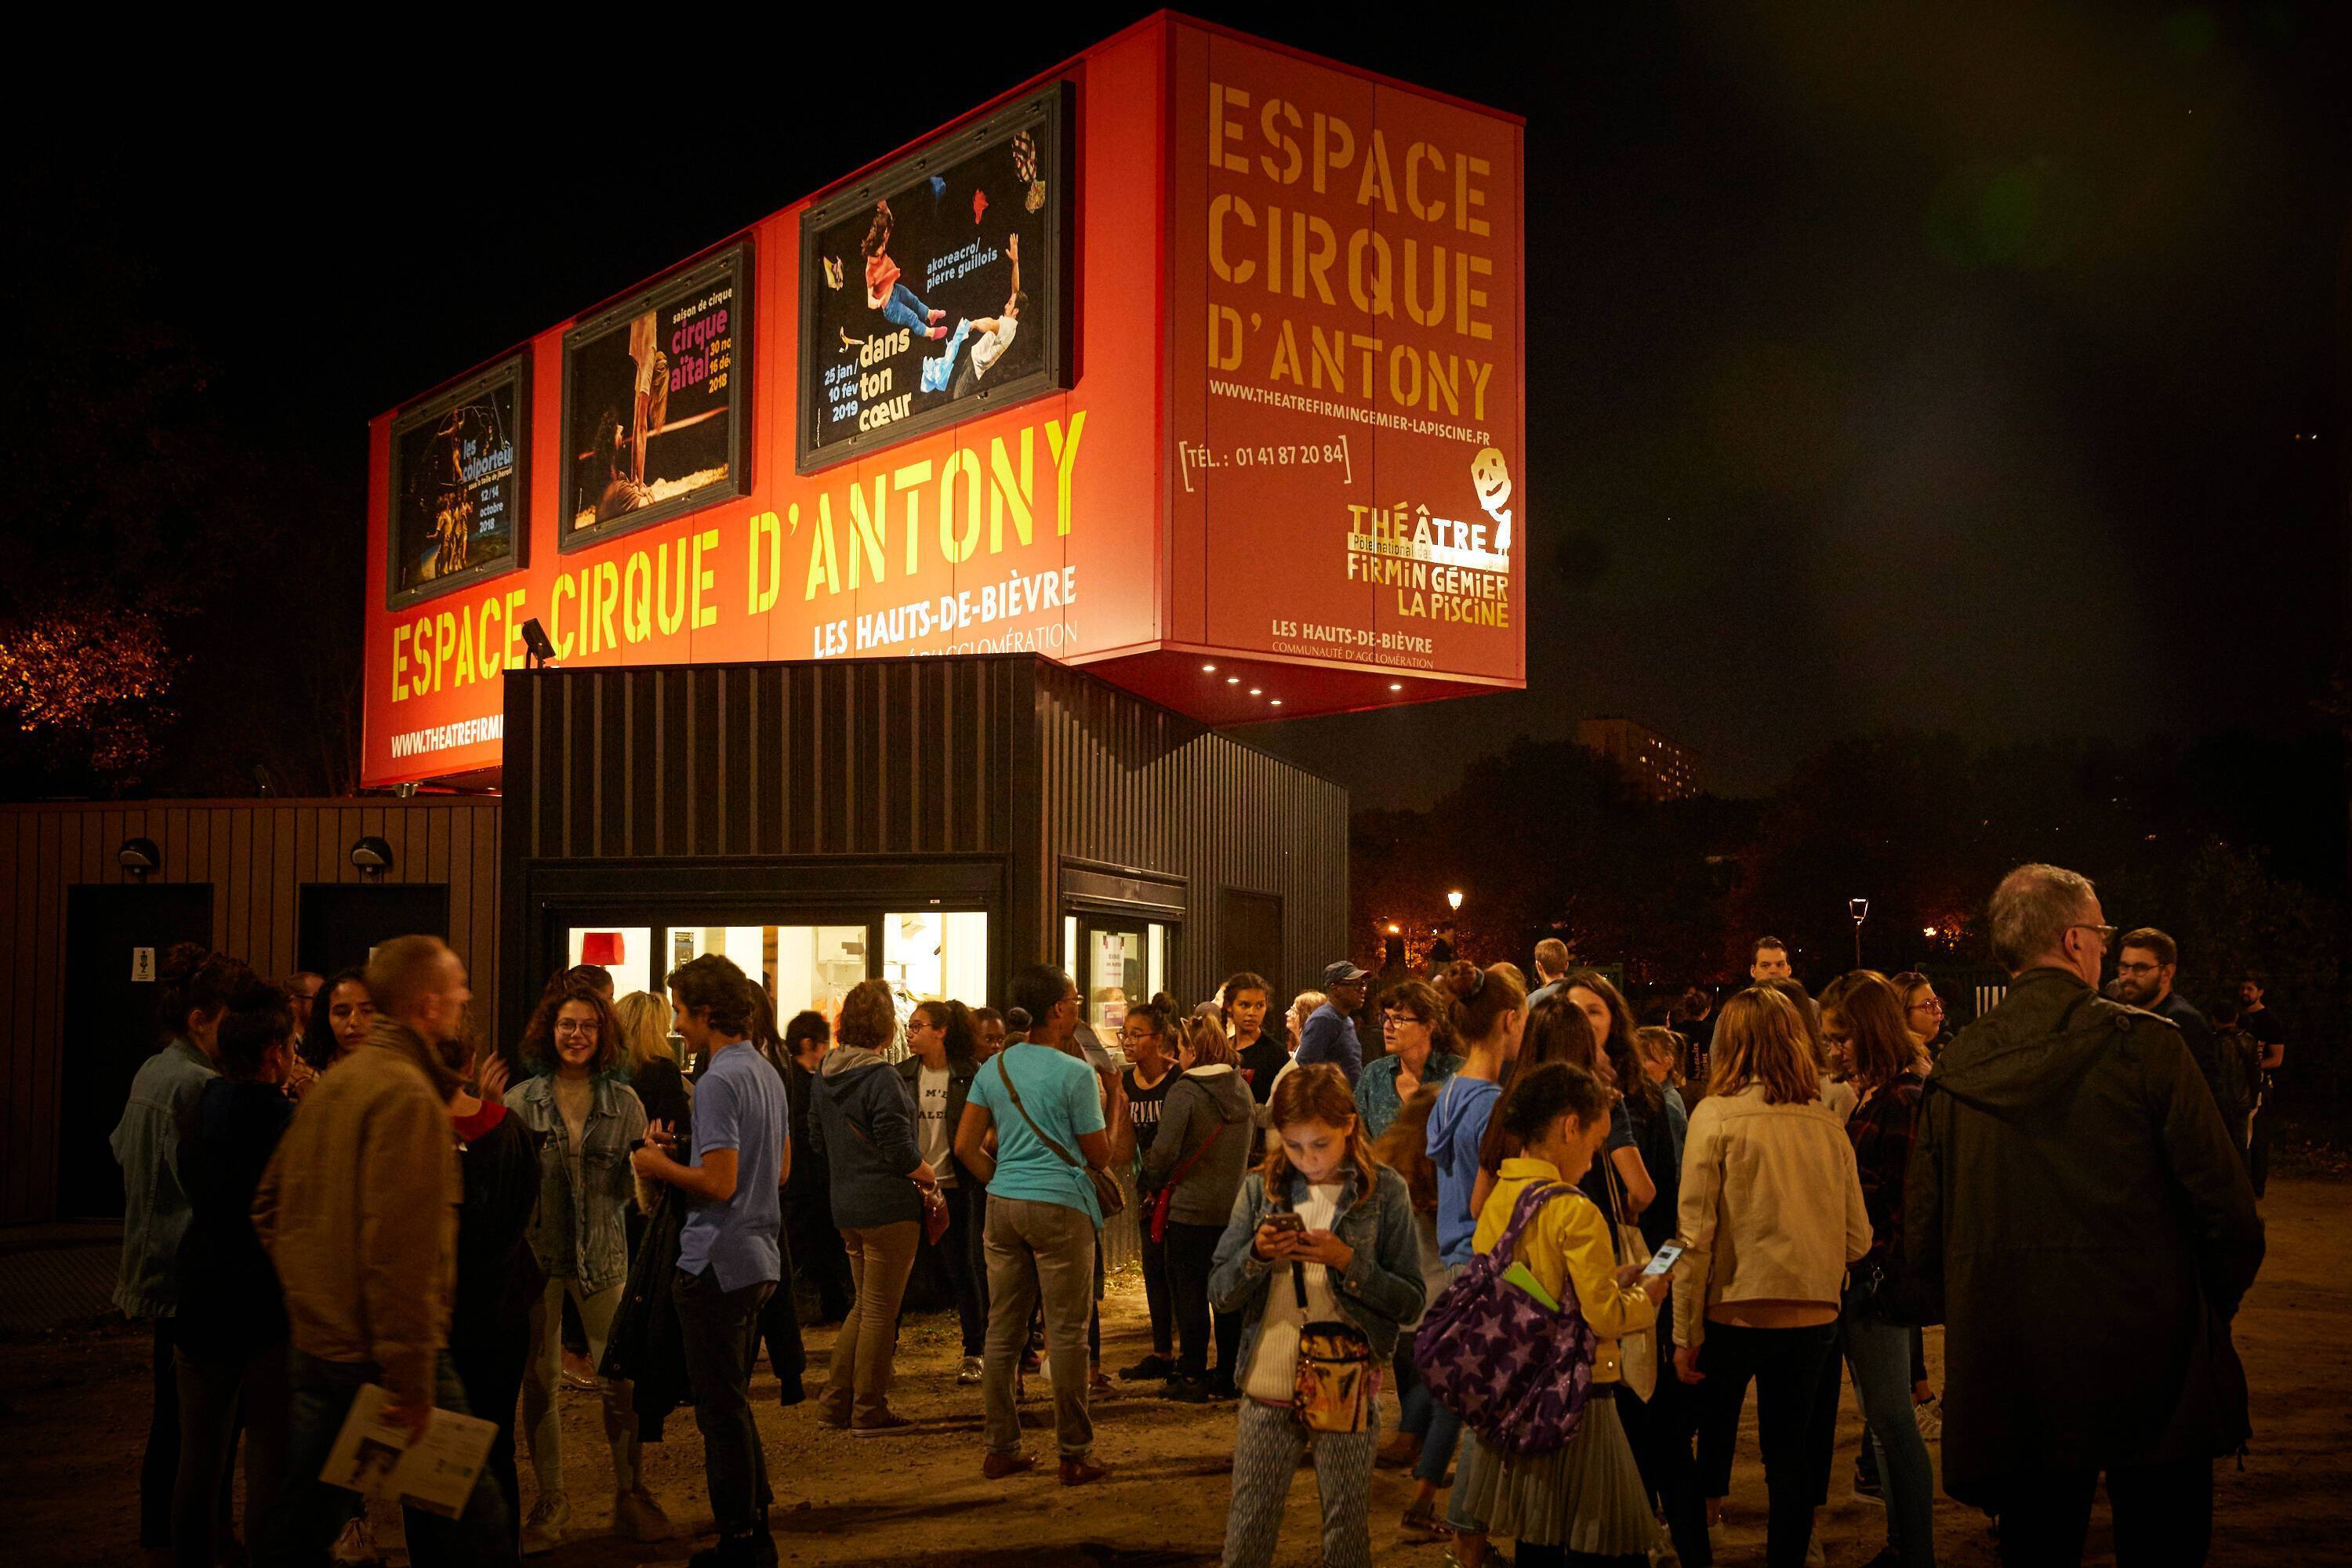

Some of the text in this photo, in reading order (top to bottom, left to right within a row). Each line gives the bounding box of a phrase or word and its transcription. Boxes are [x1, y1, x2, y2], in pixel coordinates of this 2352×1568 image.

[1209, 82, 1490, 237] ESPACE
[927, 247, 998, 293] pierre guillois
[1208, 193, 1493, 340] CIRQUE
[673, 288, 732, 324] saison de cirque
[671, 309, 728, 354] cirque
[710, 339, 720, 356] 30
[859, 328, 910, 368] dans
[670, 347, 710, 392] aïtal
[710, 358, 718, 375] 16
[824, 367, 836, 386] 25
[1208, 303, 1494, 421] D'ANTONY
[709, 372, 728, 394] 2018
[828, 380, 859, 403] 10 fév
[859, 367, 892, 401] ton
[832, 400, 858, 423] 2019
[858, 392, 912, 432] cœur
[1210, 379, 1490, 445] WWW.THEATREFIRMINGEMIER-LAPISCINE.FR
[463, 439, 477, 459] les
[1236, 448, 1254, 466] 01
[1258, 446, 1275, 465] 41
[1278, 446, 1296, 464] 87
[1300, 445, 1319, 463] 20
[479, 517, 495, 533] 2018
[480, 502, 503, 517] octobre
[748, 409, 1088, 615] D'ANTONY
[1347, 501, 1487, 552] THÉÂTRE
[1354, 534, 1414, 556] Pôle national
[550, 528, 720, 661] CIRQUE
[812, 564, 1077, 659] LES HAUTS-DE-BIÈVRE
[1397, 589, 1427, 618] LA
[392, 588, 527, 702] ESPACE
[1272, 619, 1433, 654] LES HAUTS-DE-BIÈVRE
[1272, 641, 1344, 659] COMMUNAUTÉ
